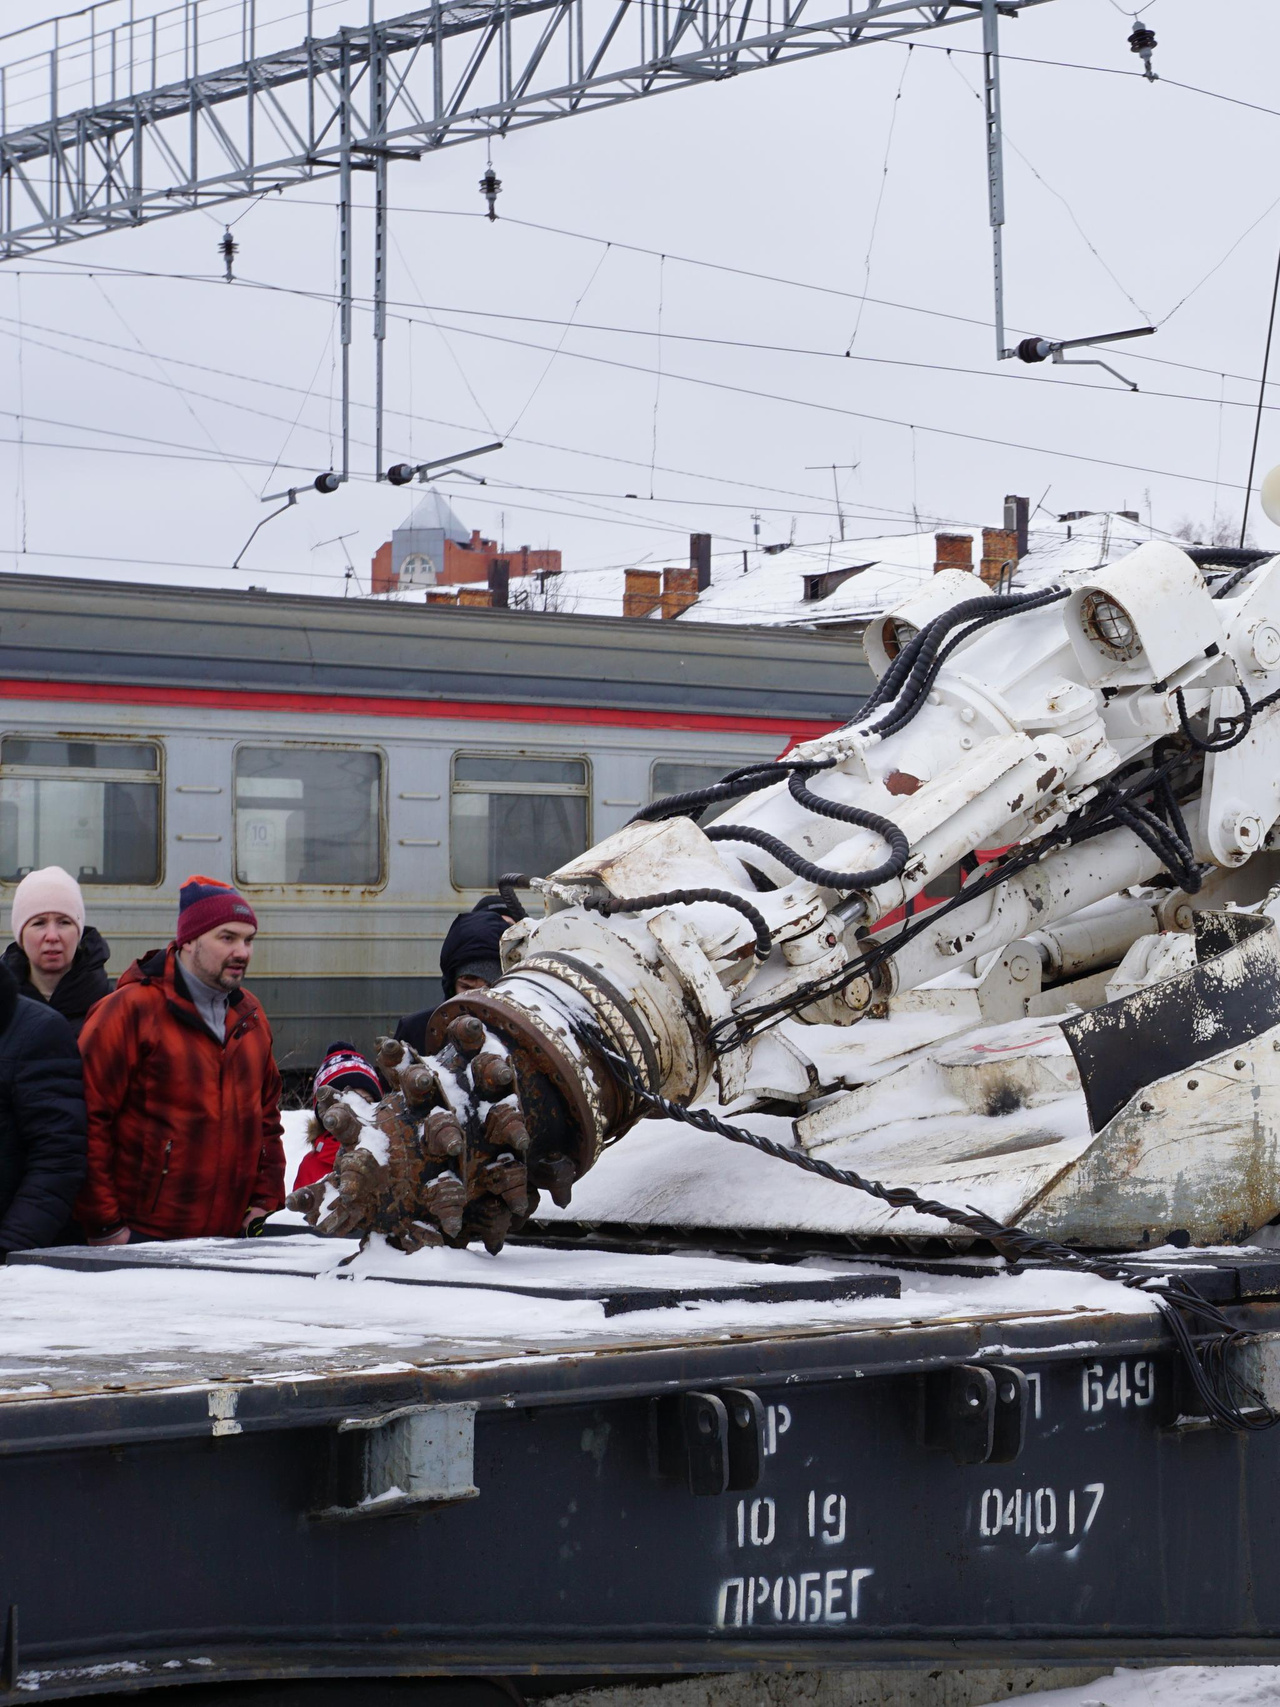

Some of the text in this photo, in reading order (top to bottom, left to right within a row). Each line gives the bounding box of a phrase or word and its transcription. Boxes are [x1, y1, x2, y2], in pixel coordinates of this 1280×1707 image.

[252, 825, 267, 841] 10
[1082, 1361, 1155, 1412] 649
[736, 1490, 847, 1548] 10 19
[717, 1568, 875, 1629] ПРОБЕГ
